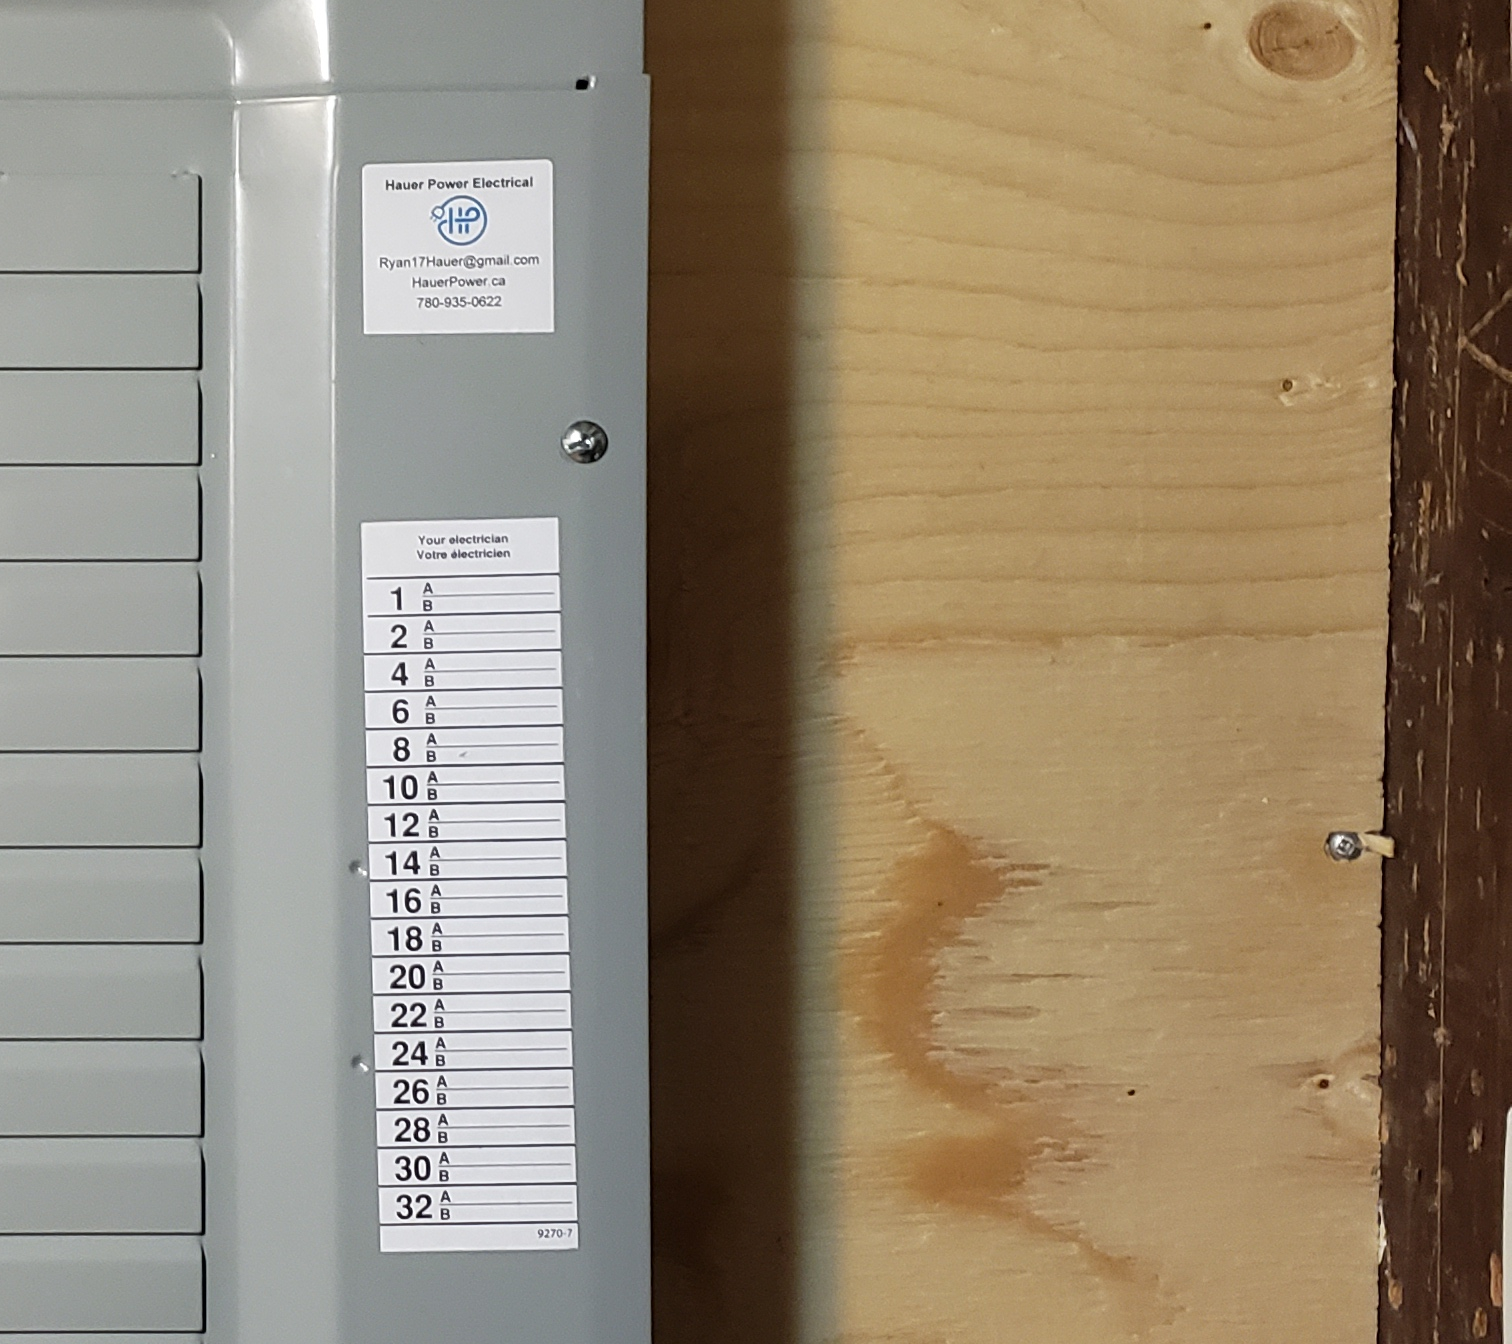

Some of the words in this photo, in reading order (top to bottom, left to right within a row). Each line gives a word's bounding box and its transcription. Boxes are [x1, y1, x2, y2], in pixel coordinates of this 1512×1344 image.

[386, 180, 424, 190] Hauer
[428, 179, 468, 189] Power
[473, 176, 533, 188] Electrical
[380, 255, 539, 271] Ryan17Hauer@gmail.com
[413, 276, 505, 288] HauerPower.ca
[417, 296, 502, 308] 780-935-0622
[418, 536, 445, 545] Your
[449, 534, 508, 544] electrician
[417, 550, 447, 559] Votre
[451, 549, 510, 559] électricien
[391, 587, 402, 610] 1
[391, 624, 407, 648] 2
[391, 662, 408, 686] 4
[393, 699, 409, 724] 6
[393, 737, 410, 762] 8
[383, 775, 418, 800] 10
[384, 812, 419, 837] 12
[385, 851, 420, 875] 14
[387, 888, 421, 913] 16
[388, 926, 423, 951] 18
[390, 964, 425, 989] 20
[391, 1003, 427, 1027] 22
[392, 1041, 428, 1066] 24
[393, 1079, 429, 1104] 26
[395, 1117, 430, 1142] 28
[395, 1156, 431, 1181] 30
[397, 1194, 432, 1219] 32
[538, 1228, 572, 1238] 9270-7
